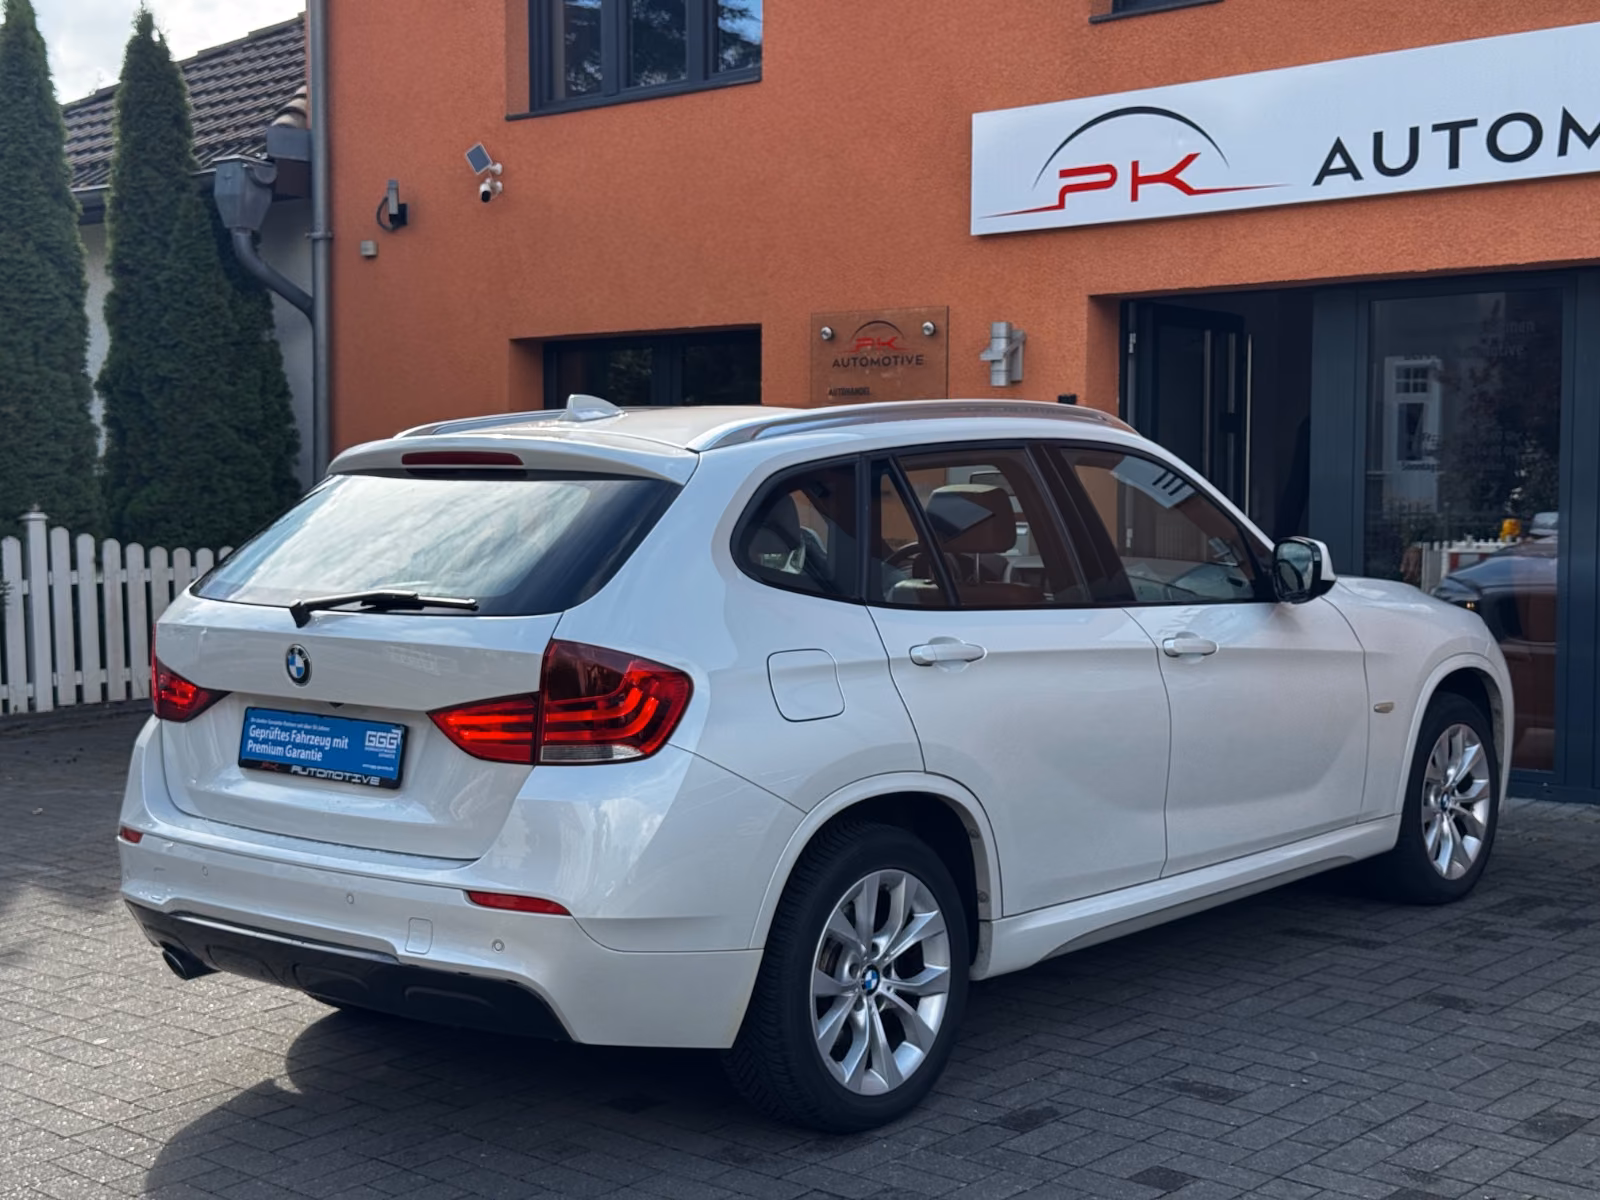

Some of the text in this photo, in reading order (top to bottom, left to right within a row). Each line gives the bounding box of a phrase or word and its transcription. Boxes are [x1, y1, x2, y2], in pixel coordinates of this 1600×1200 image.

[1059, 105, 1600, 210] PK AUTOM
[832, 354, 925, 369] AUTOMOTIVE
[249, 724, 289, 742] Geprüftes
[290, 729, 332, 750] Fahrzeug
[332, 735, 349, 749] mit
[247, 740, 323, 762] Premium Garantie
[290, 764, 381, 786] AUTOMOTIVE
